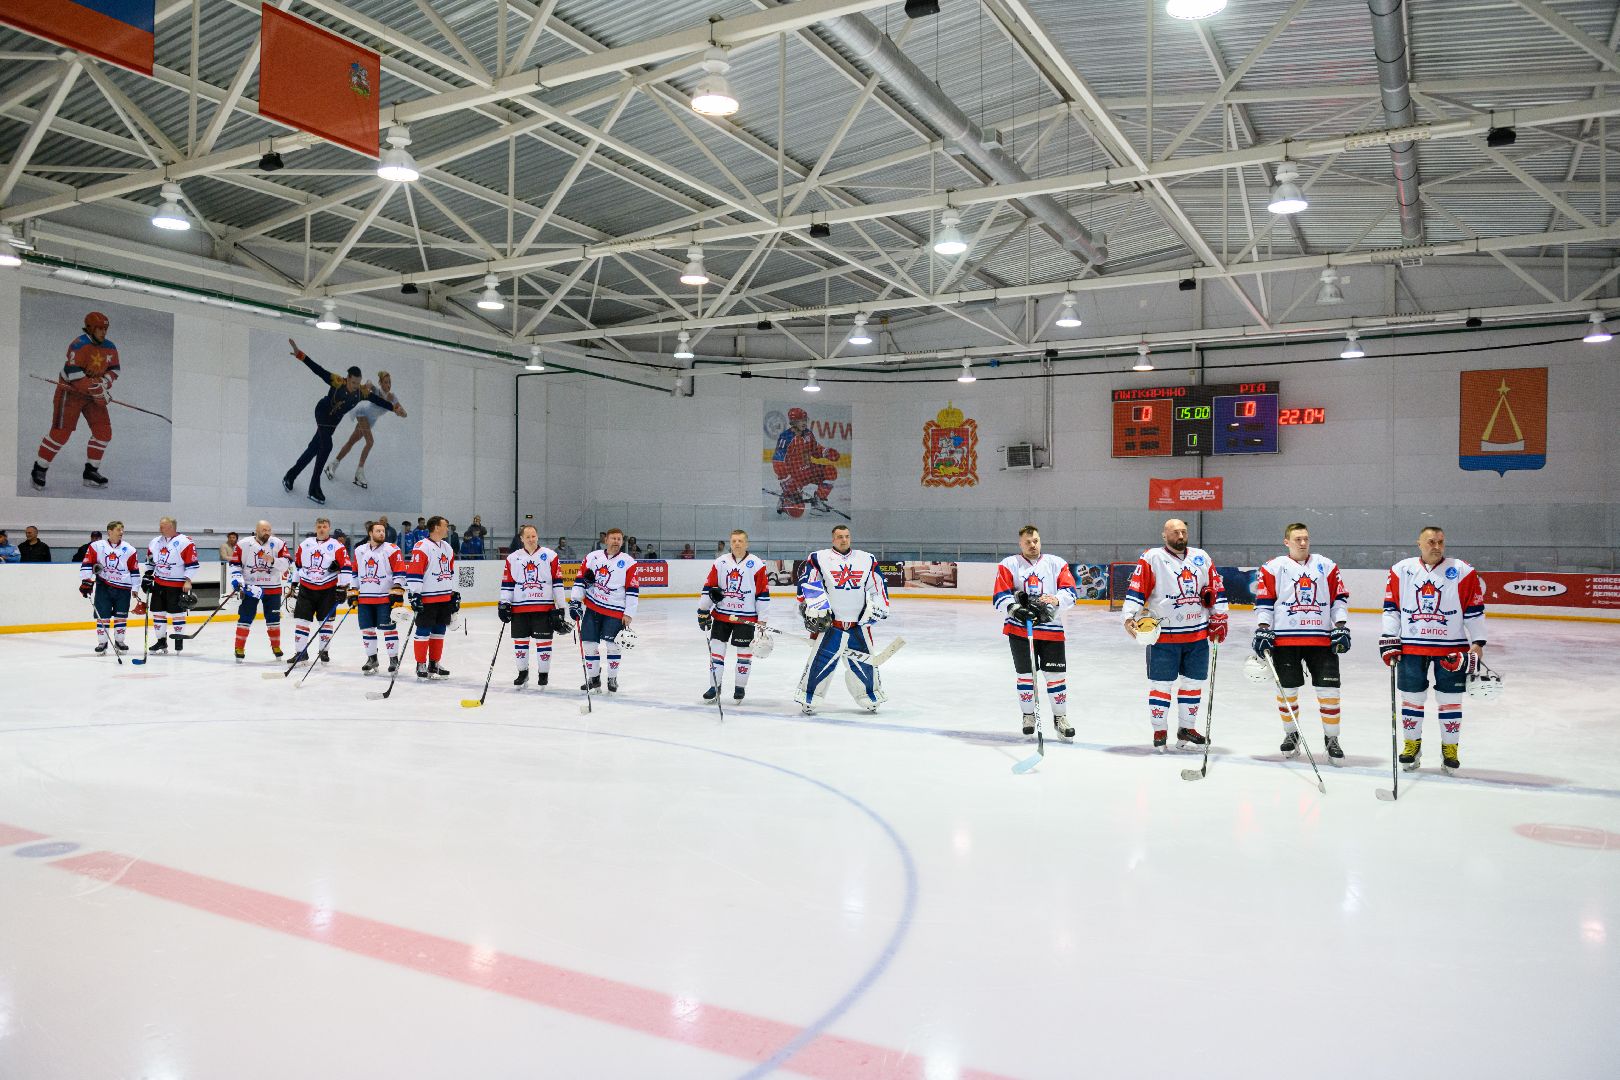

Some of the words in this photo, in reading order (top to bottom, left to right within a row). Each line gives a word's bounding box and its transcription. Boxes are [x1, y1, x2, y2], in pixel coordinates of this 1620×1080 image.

[1142, 406, 1152, 421] 0
[1244, 401, 1256, 417] 0
[1279, 408, 1325, 425] 22.04
[1420, 628, 1448, 636] ДИПОС
